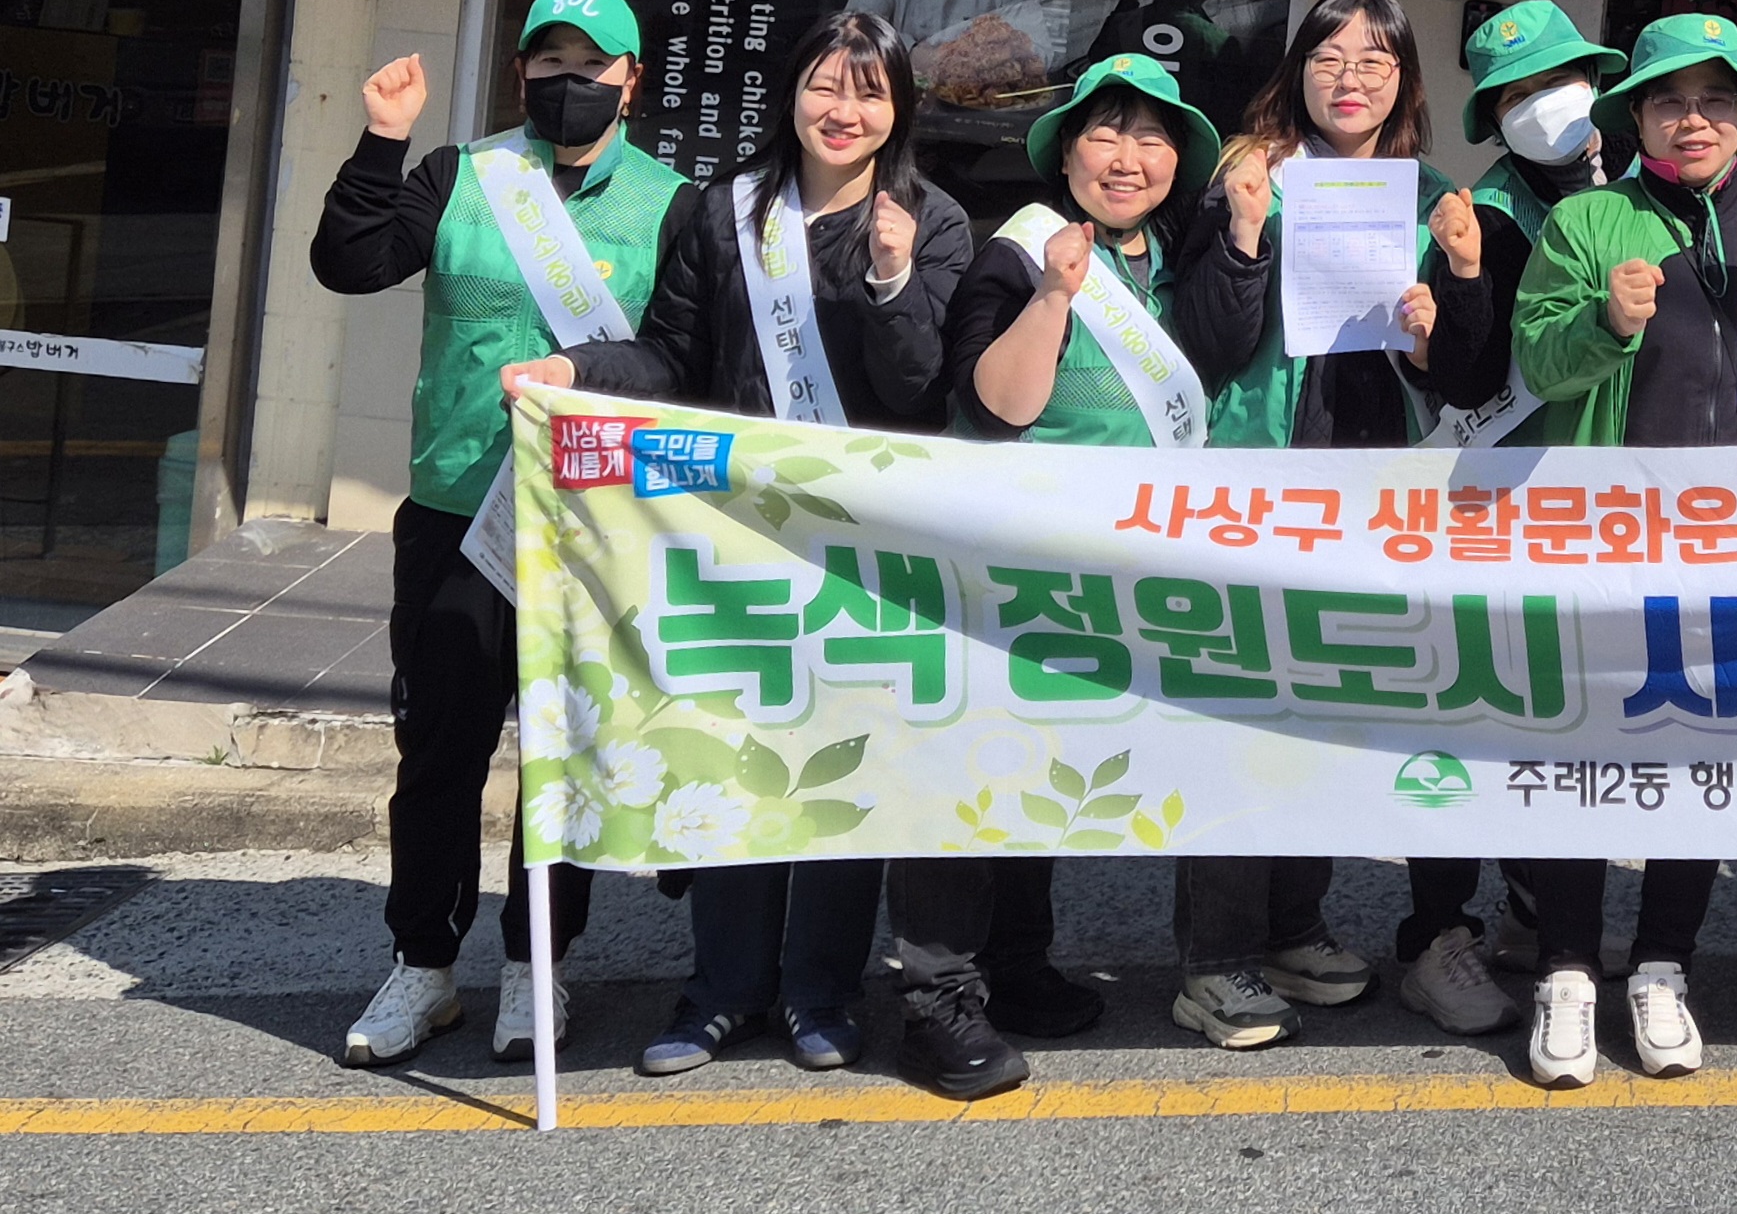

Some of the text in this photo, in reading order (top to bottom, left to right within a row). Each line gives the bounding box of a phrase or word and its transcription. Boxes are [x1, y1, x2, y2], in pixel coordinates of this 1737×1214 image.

[662, 35, 691, 109] whole
[698, 91, 722, 139] and
[736, 70, 768, 162] chicke
[771, 294, 802, 357] 선택
[560, 420, 627, 450] 사상을
[641, 433, 721, 462] 구민을
[559, 448, 626, 481] 새롭게
[644, 463, 719, 492] 힘나게
[1113, 482, 1345, 554] 사상구
[656, 543, 948, 708] 녹색
[985, 564, 1567, 720] 정원도시
[1505, 759, 1669, 811] 주례2동
